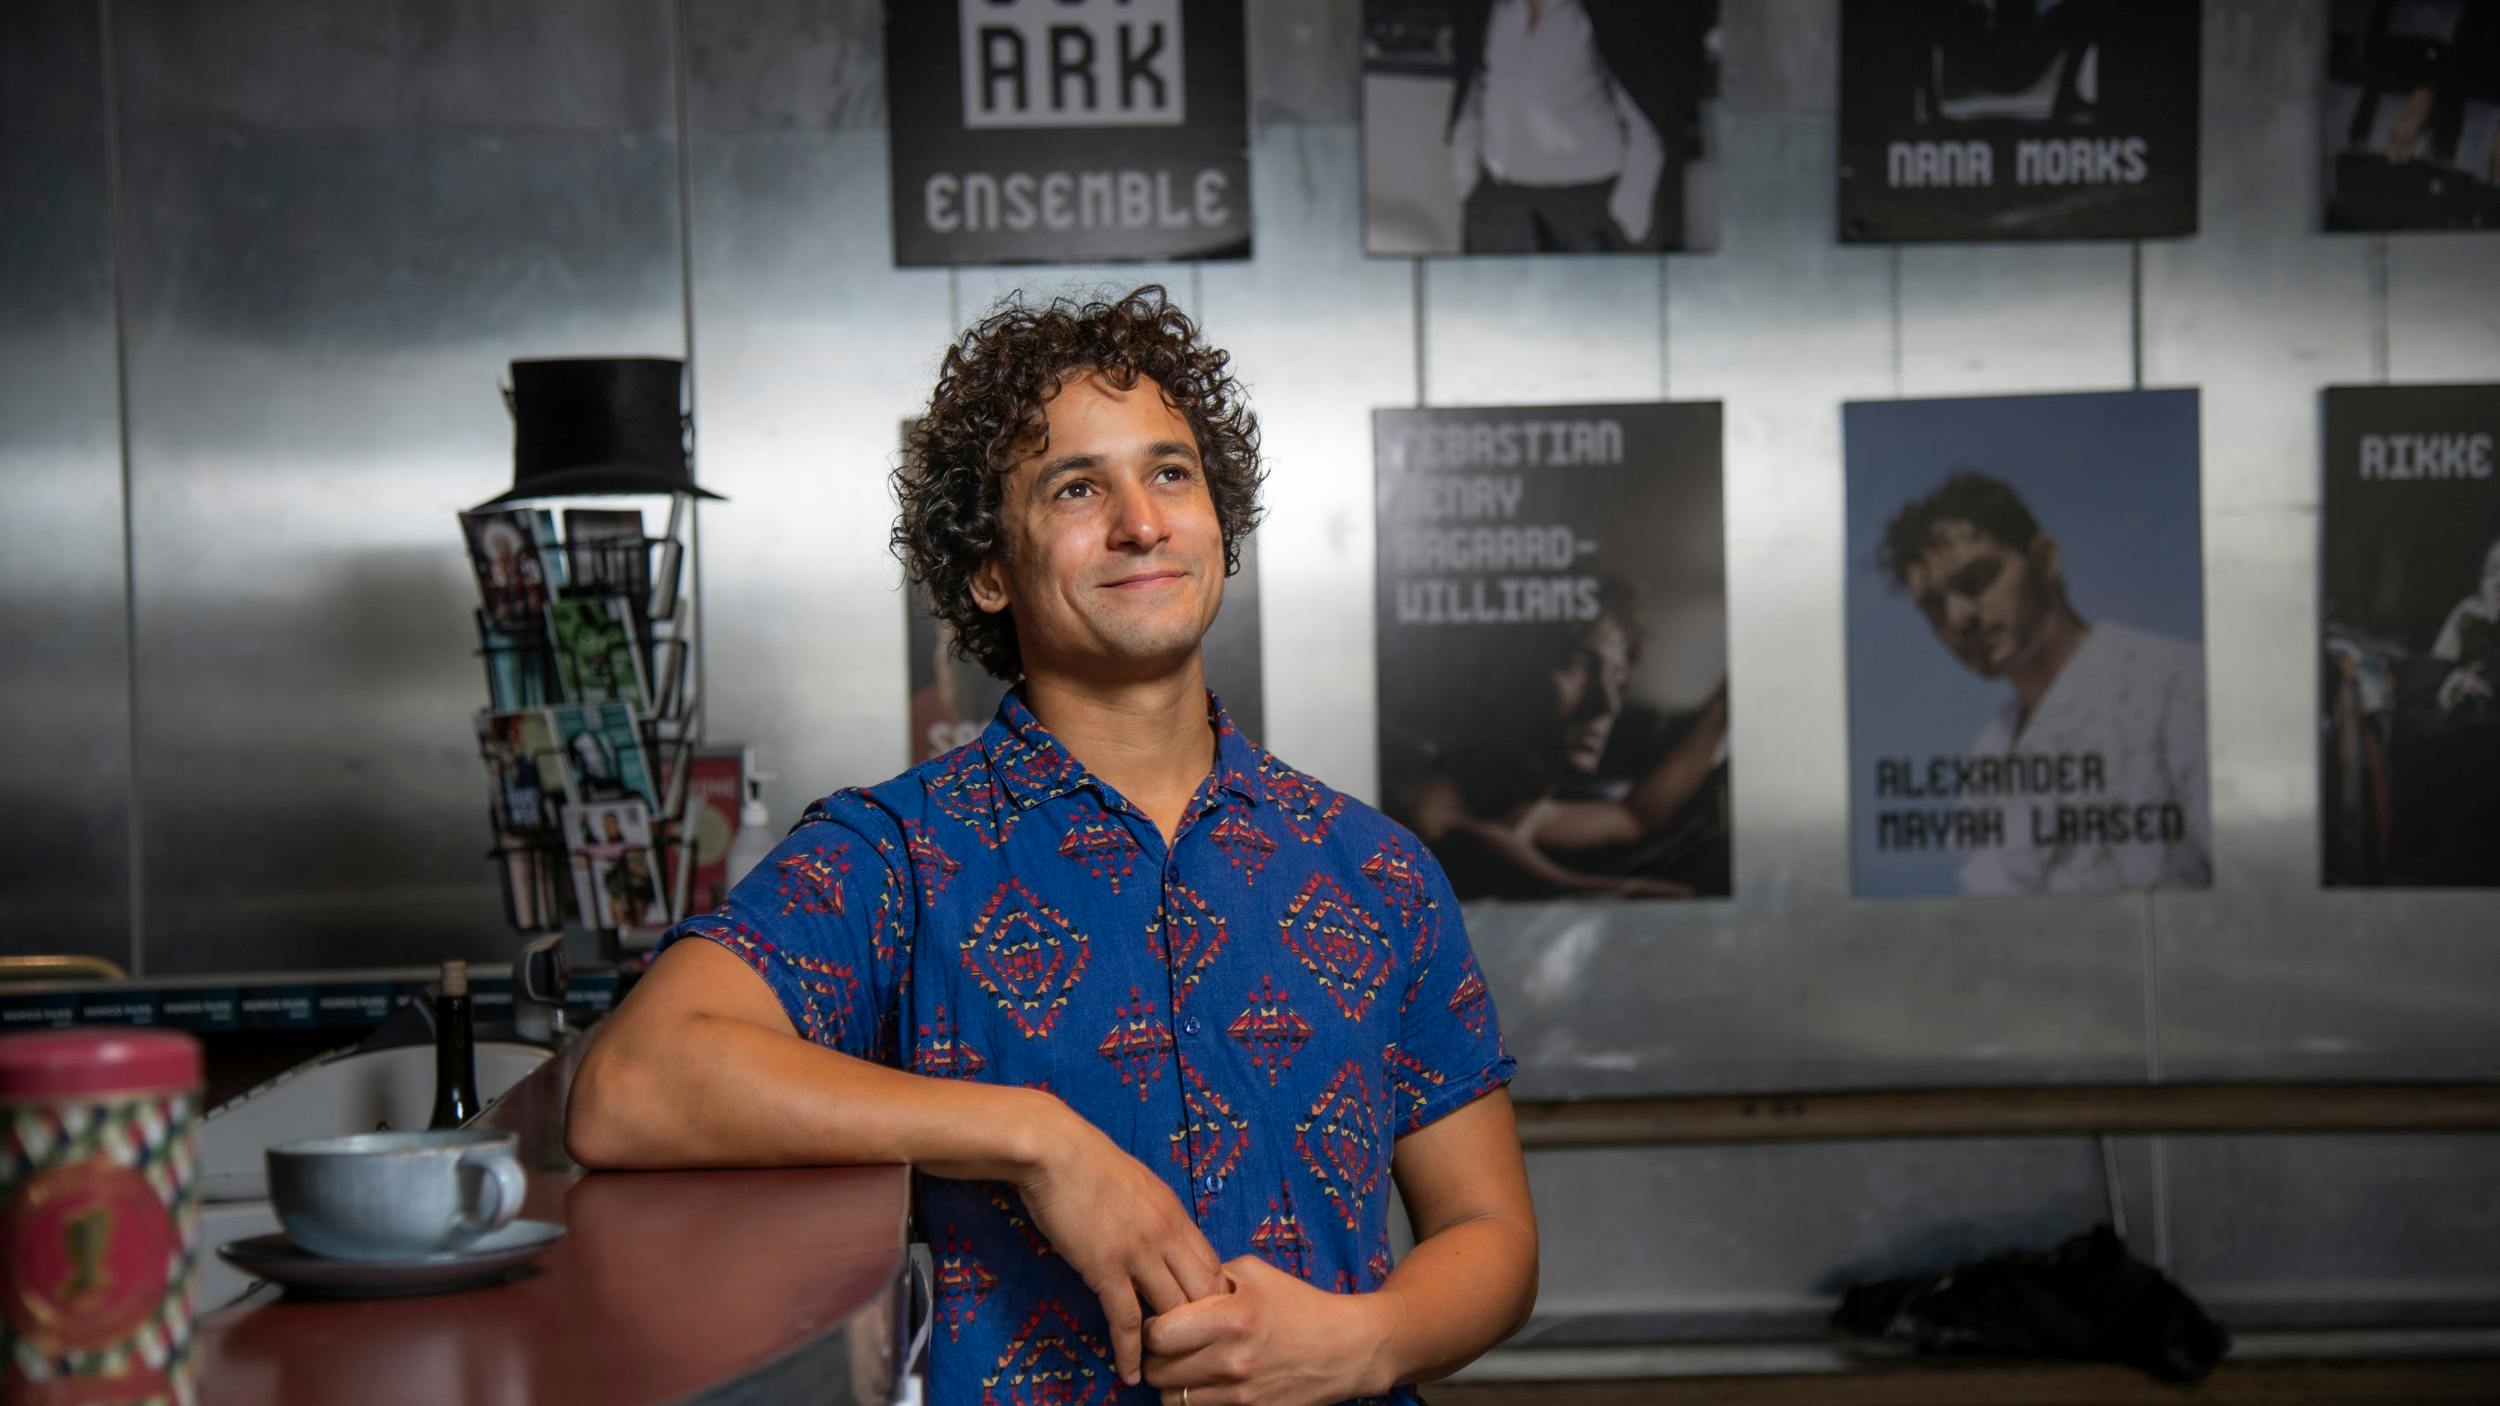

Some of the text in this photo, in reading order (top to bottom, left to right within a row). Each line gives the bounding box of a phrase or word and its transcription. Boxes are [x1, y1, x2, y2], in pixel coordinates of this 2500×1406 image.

[978, 25, 1166, 111] ARK
[1887, 136, 2148, 187] NANA MORKS
[925, 168, 1230, 233] ENSEMBLE
[2360, 433, 2493, 480] RIKKE
[1397, 475, 1522, 521] ENRY
[1396, 575, 1602, 624] WILLIAMS
[1876, 751, 2106, 800] ALEXANDER
[1877, 801, 2186, 852] MAYAH LARSEN
